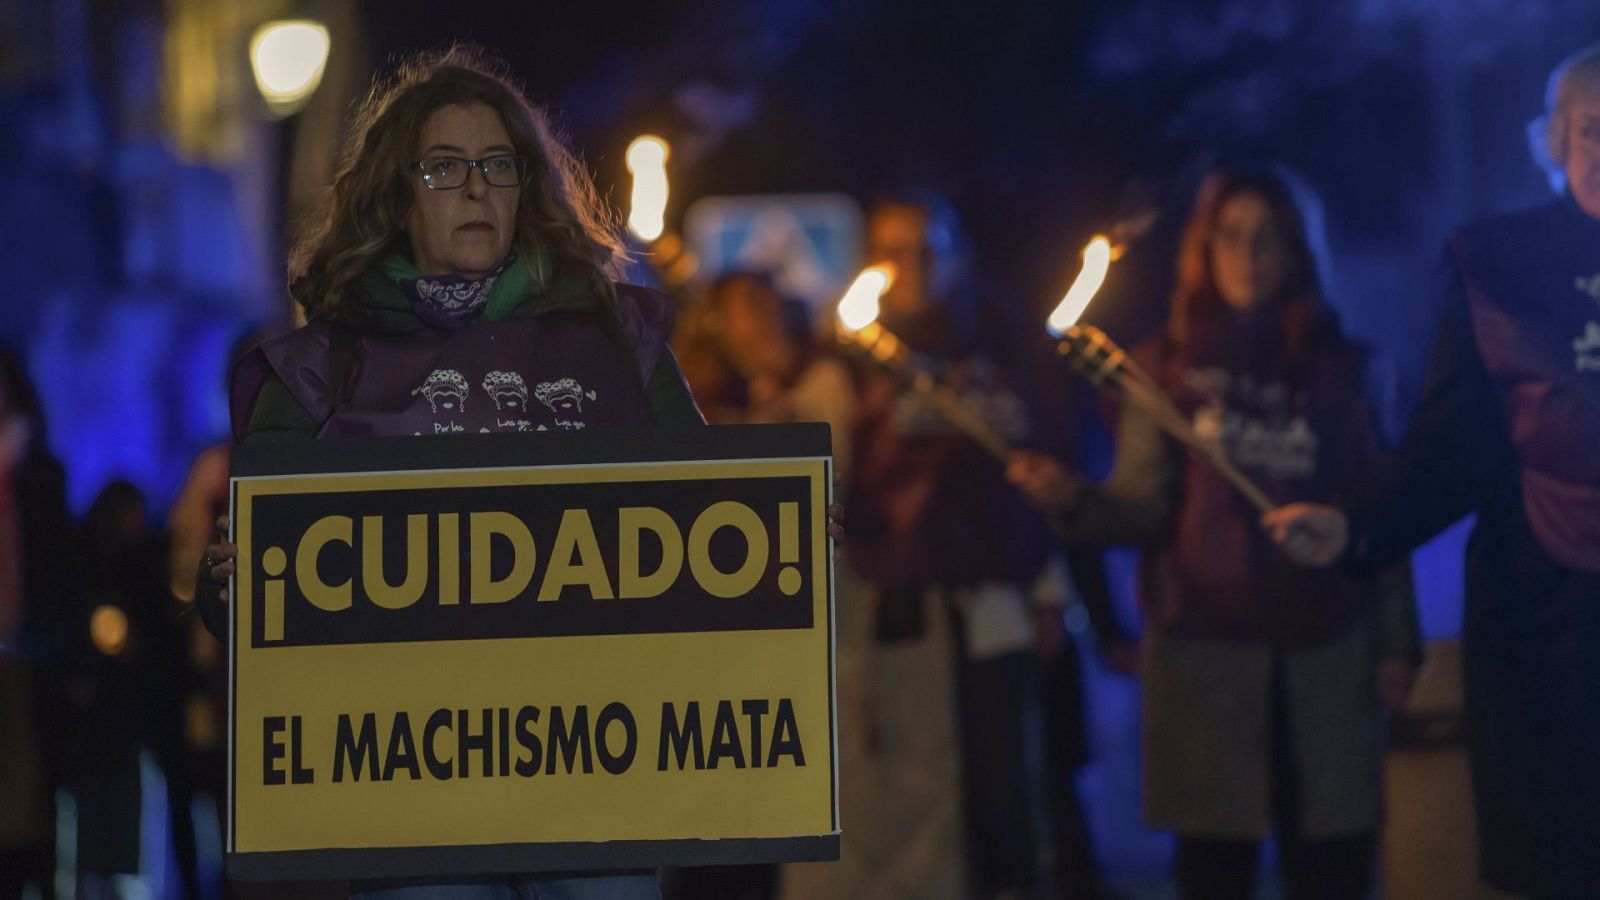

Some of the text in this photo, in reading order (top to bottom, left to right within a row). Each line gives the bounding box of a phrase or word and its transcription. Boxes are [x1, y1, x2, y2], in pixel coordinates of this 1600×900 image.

[433, 420, 465, 434] Por las
[262, 500, 801, 642] ¡CUIDADO!
[262, 697, 807, 786] EL MACHISMO MATA
